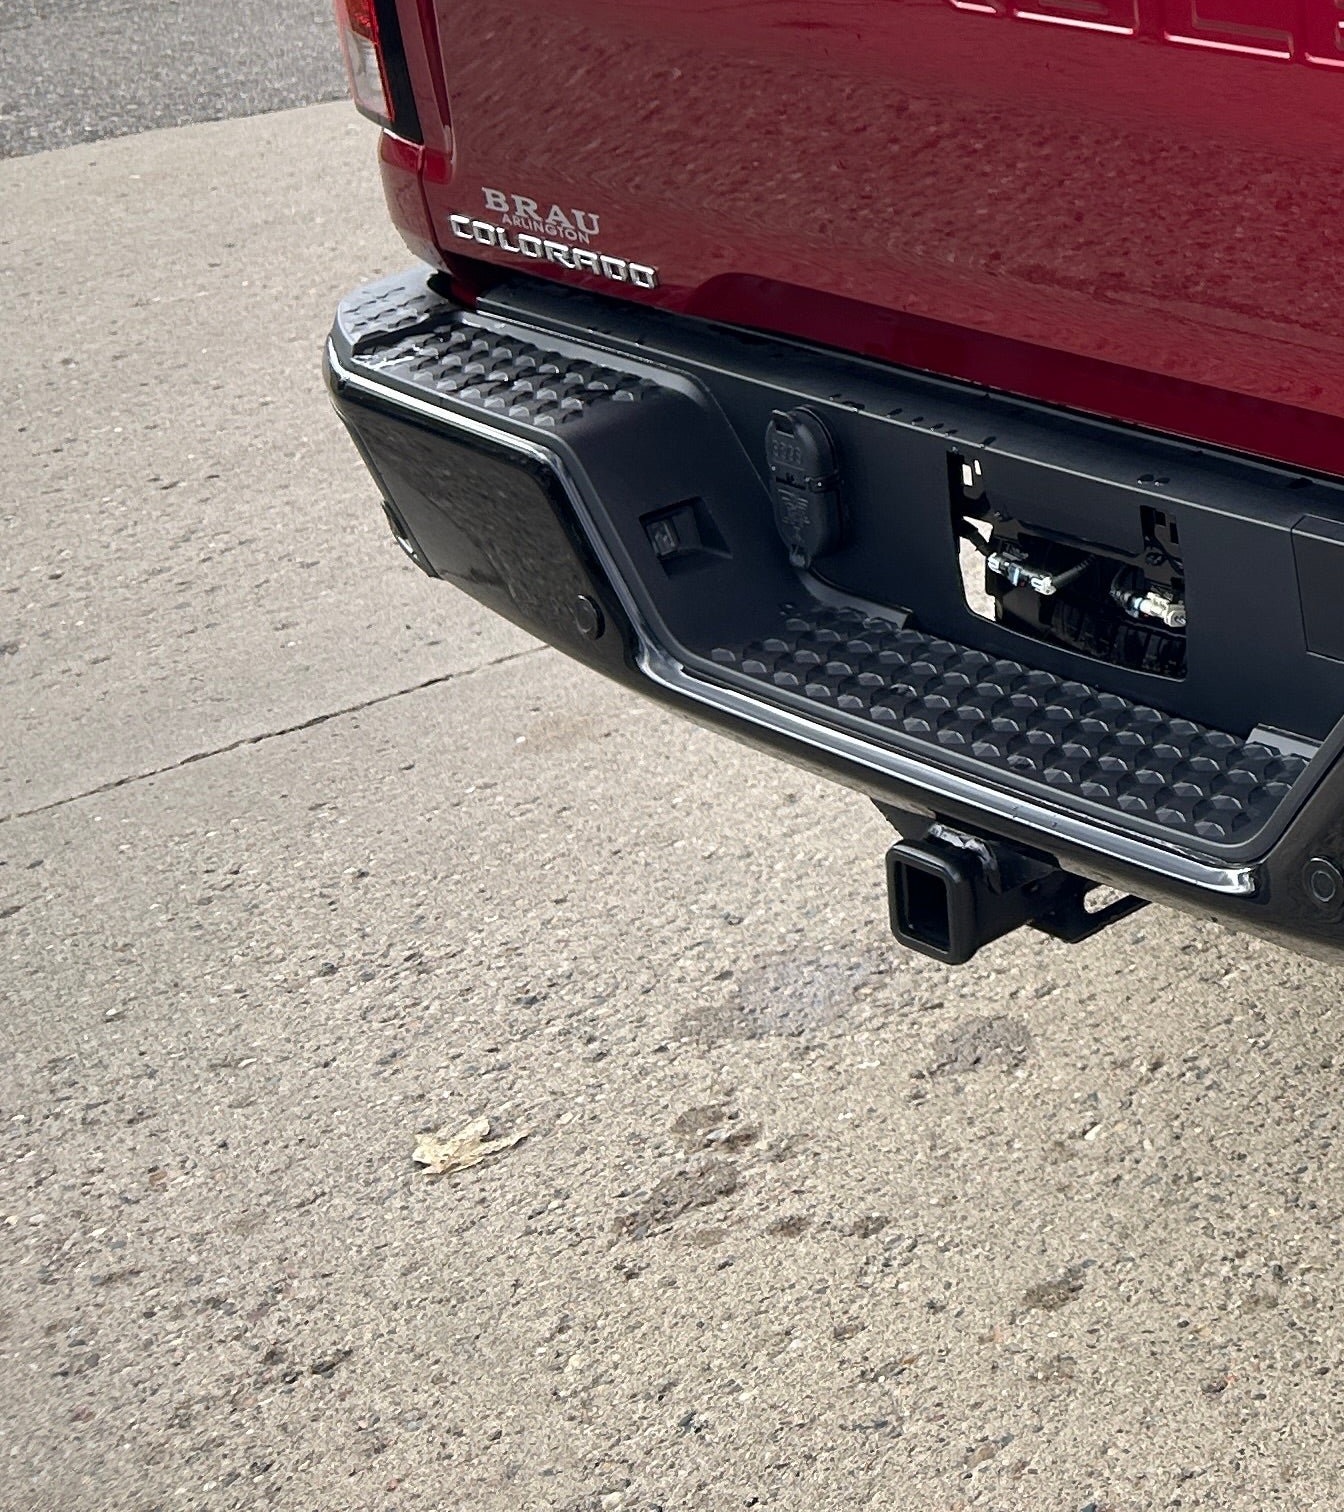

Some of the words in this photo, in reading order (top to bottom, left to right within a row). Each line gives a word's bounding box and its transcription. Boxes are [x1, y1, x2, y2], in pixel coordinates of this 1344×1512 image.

[481, 186, 600, 235] BRAU
[502, 213, 589, 244] ARLINGTON
[449, 214, 659, 289] COLORADO
